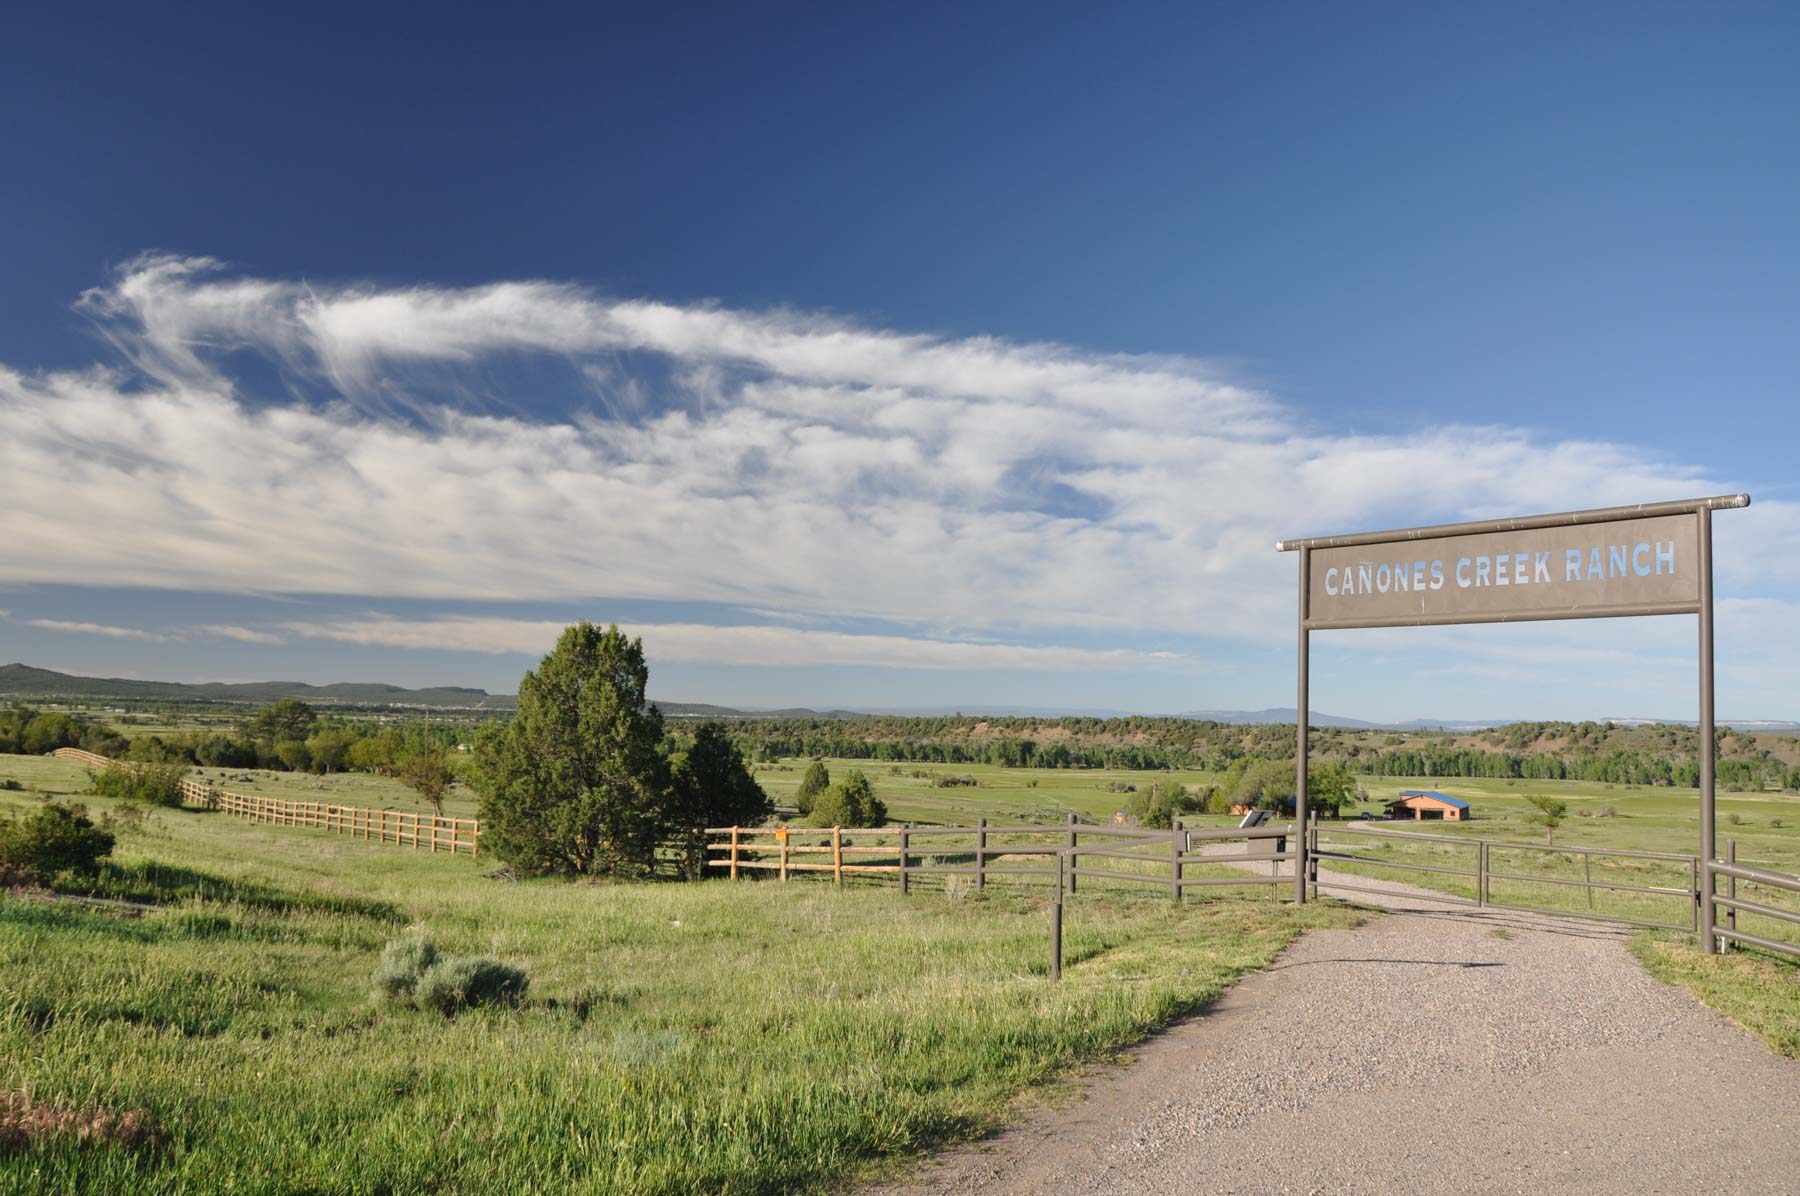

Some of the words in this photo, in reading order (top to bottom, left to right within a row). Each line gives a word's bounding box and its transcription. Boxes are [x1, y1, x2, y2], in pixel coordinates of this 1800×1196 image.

[1325, 560, 1444, 596] CAÑONES
[1456, 551, 1552, 588] CREEK
[1565, 540, 1675, 582] RANCH
